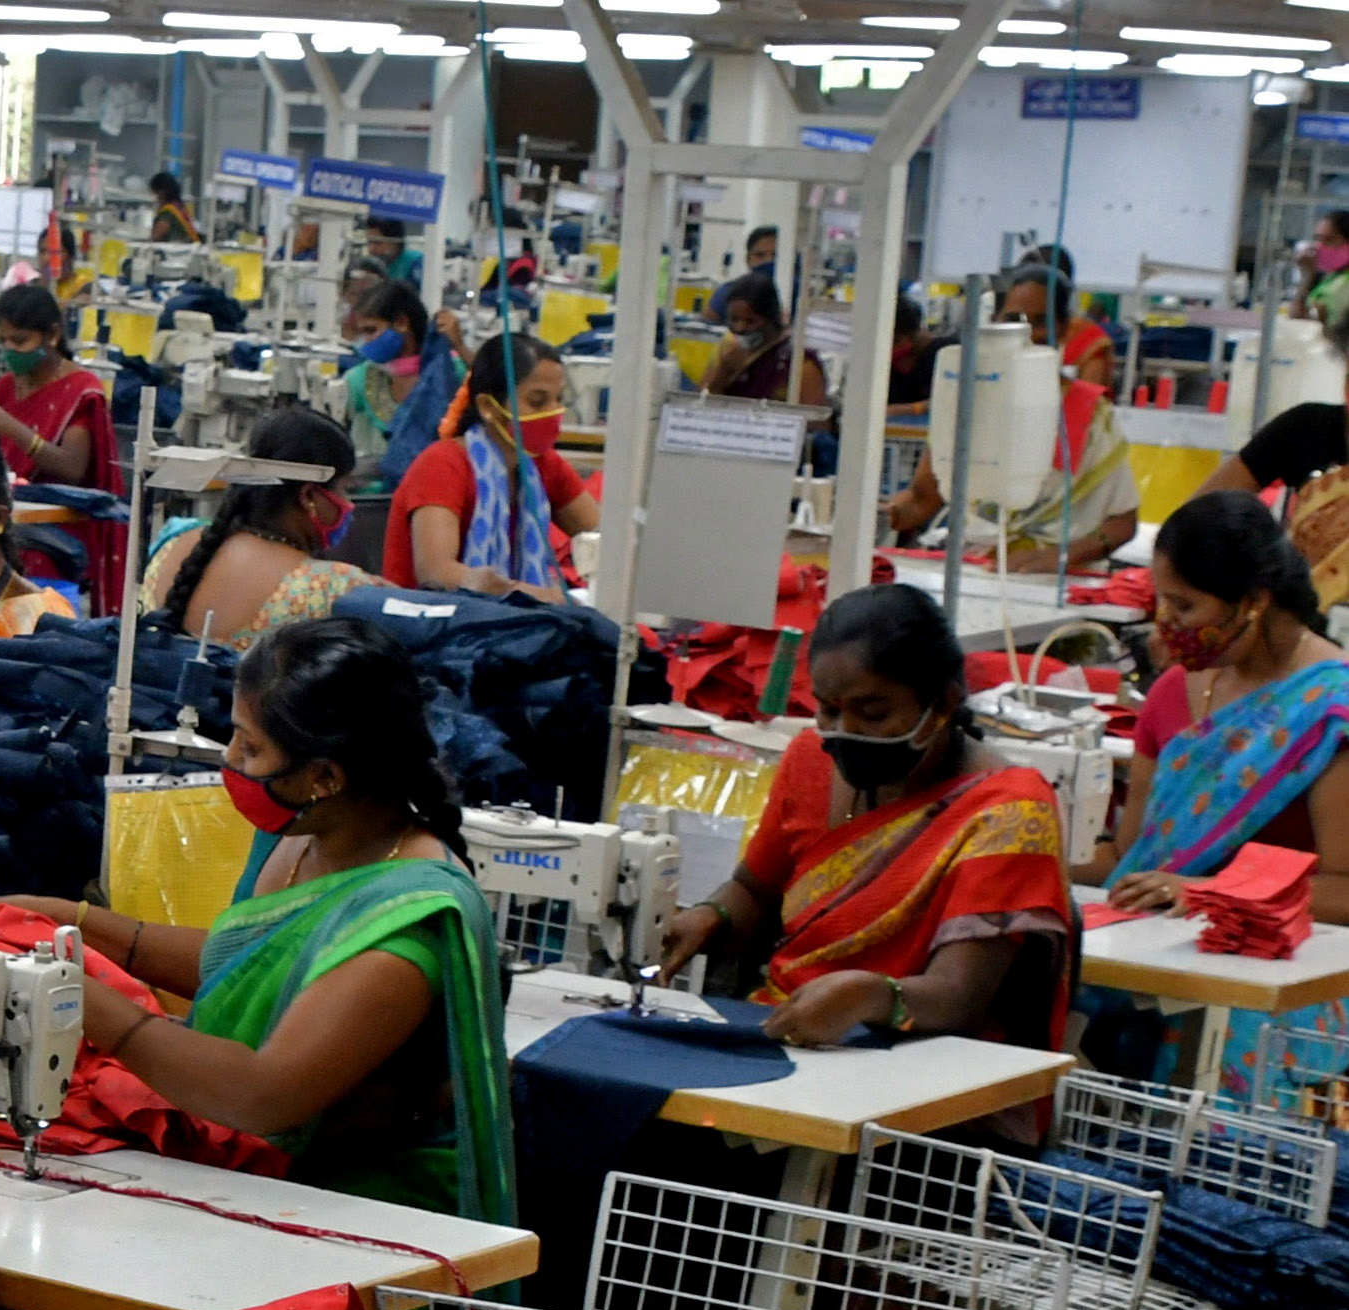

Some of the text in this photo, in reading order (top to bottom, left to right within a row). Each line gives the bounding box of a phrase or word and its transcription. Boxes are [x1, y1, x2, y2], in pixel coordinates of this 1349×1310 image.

[311, 170, 436, 208] CRITICAL OPERATION
[494, 851, 561, 870] JUKI
